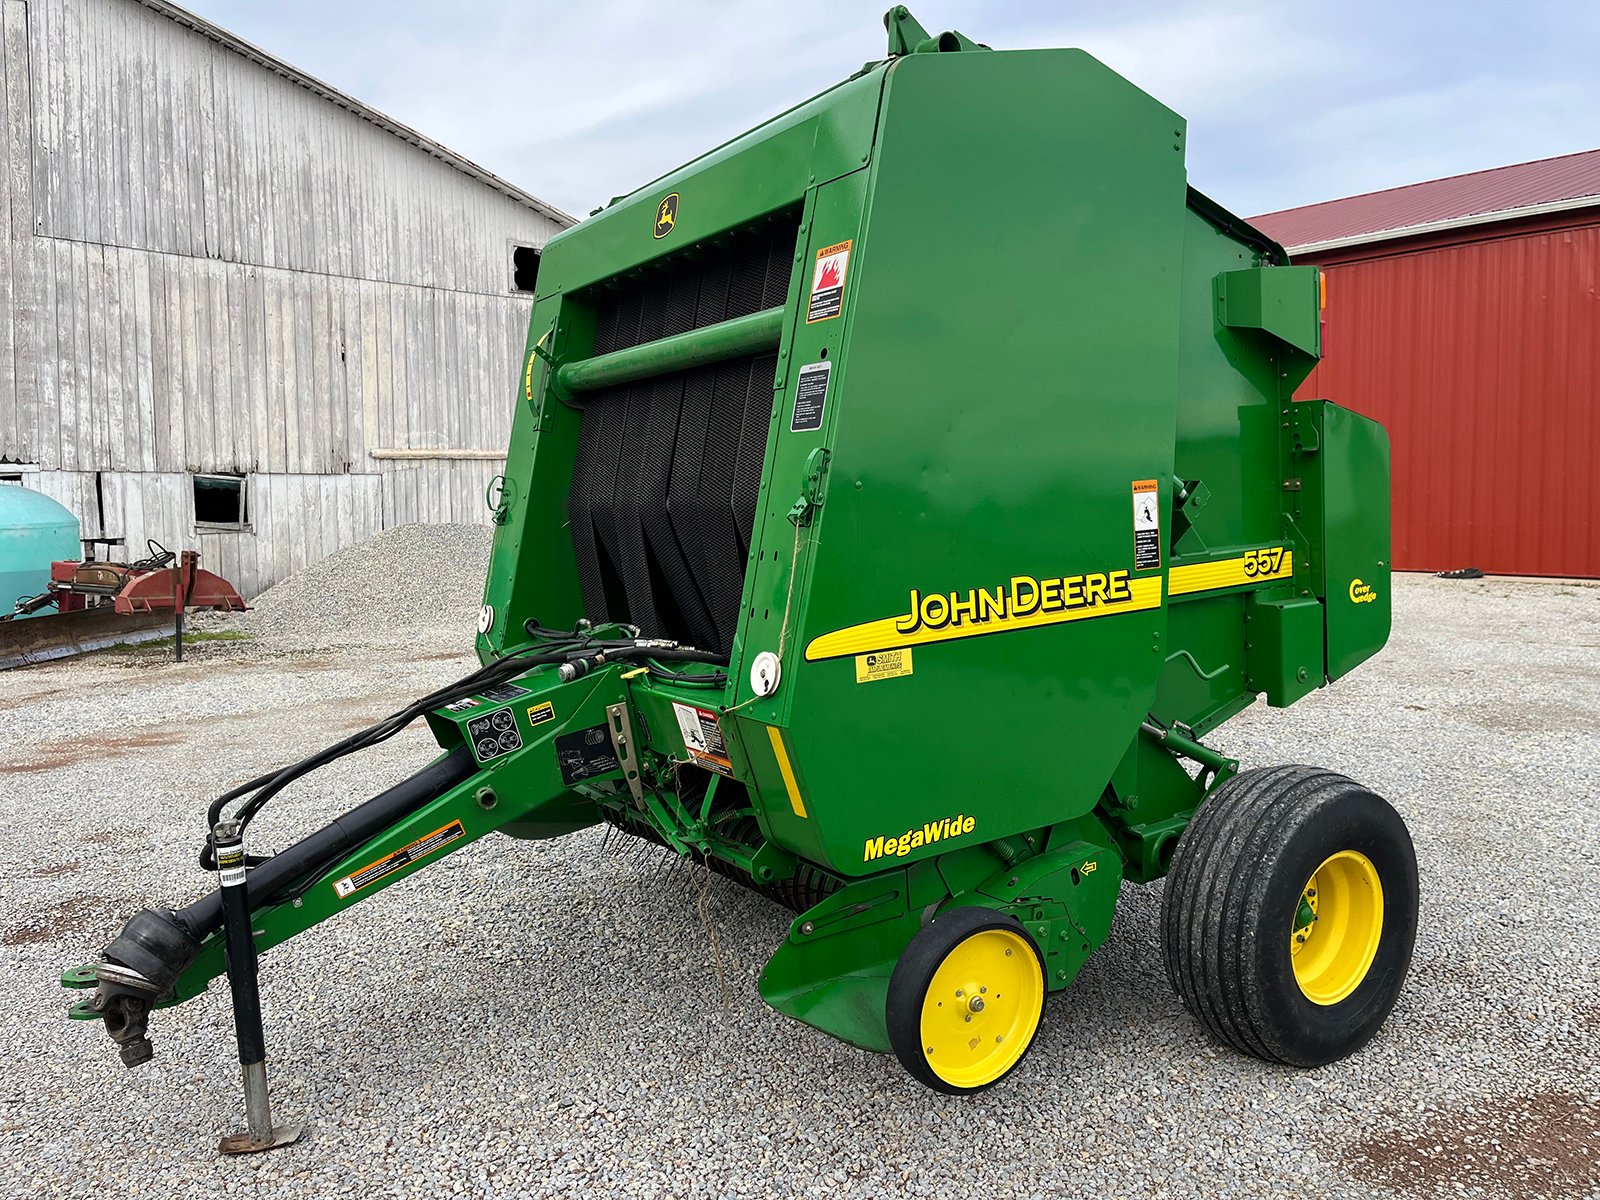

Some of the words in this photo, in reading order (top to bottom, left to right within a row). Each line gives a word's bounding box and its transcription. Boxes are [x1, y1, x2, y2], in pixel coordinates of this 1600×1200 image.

[824, 242, 849, 255] WARNING
[1244, 546, 1284, 577] 557
[896, 585, 1007, 633] JOHN
[1010, 569, 1132, 617] DEERE
[877, 651, 902, 664] SMITH
[863, 814, 976, 862] MegaWide
